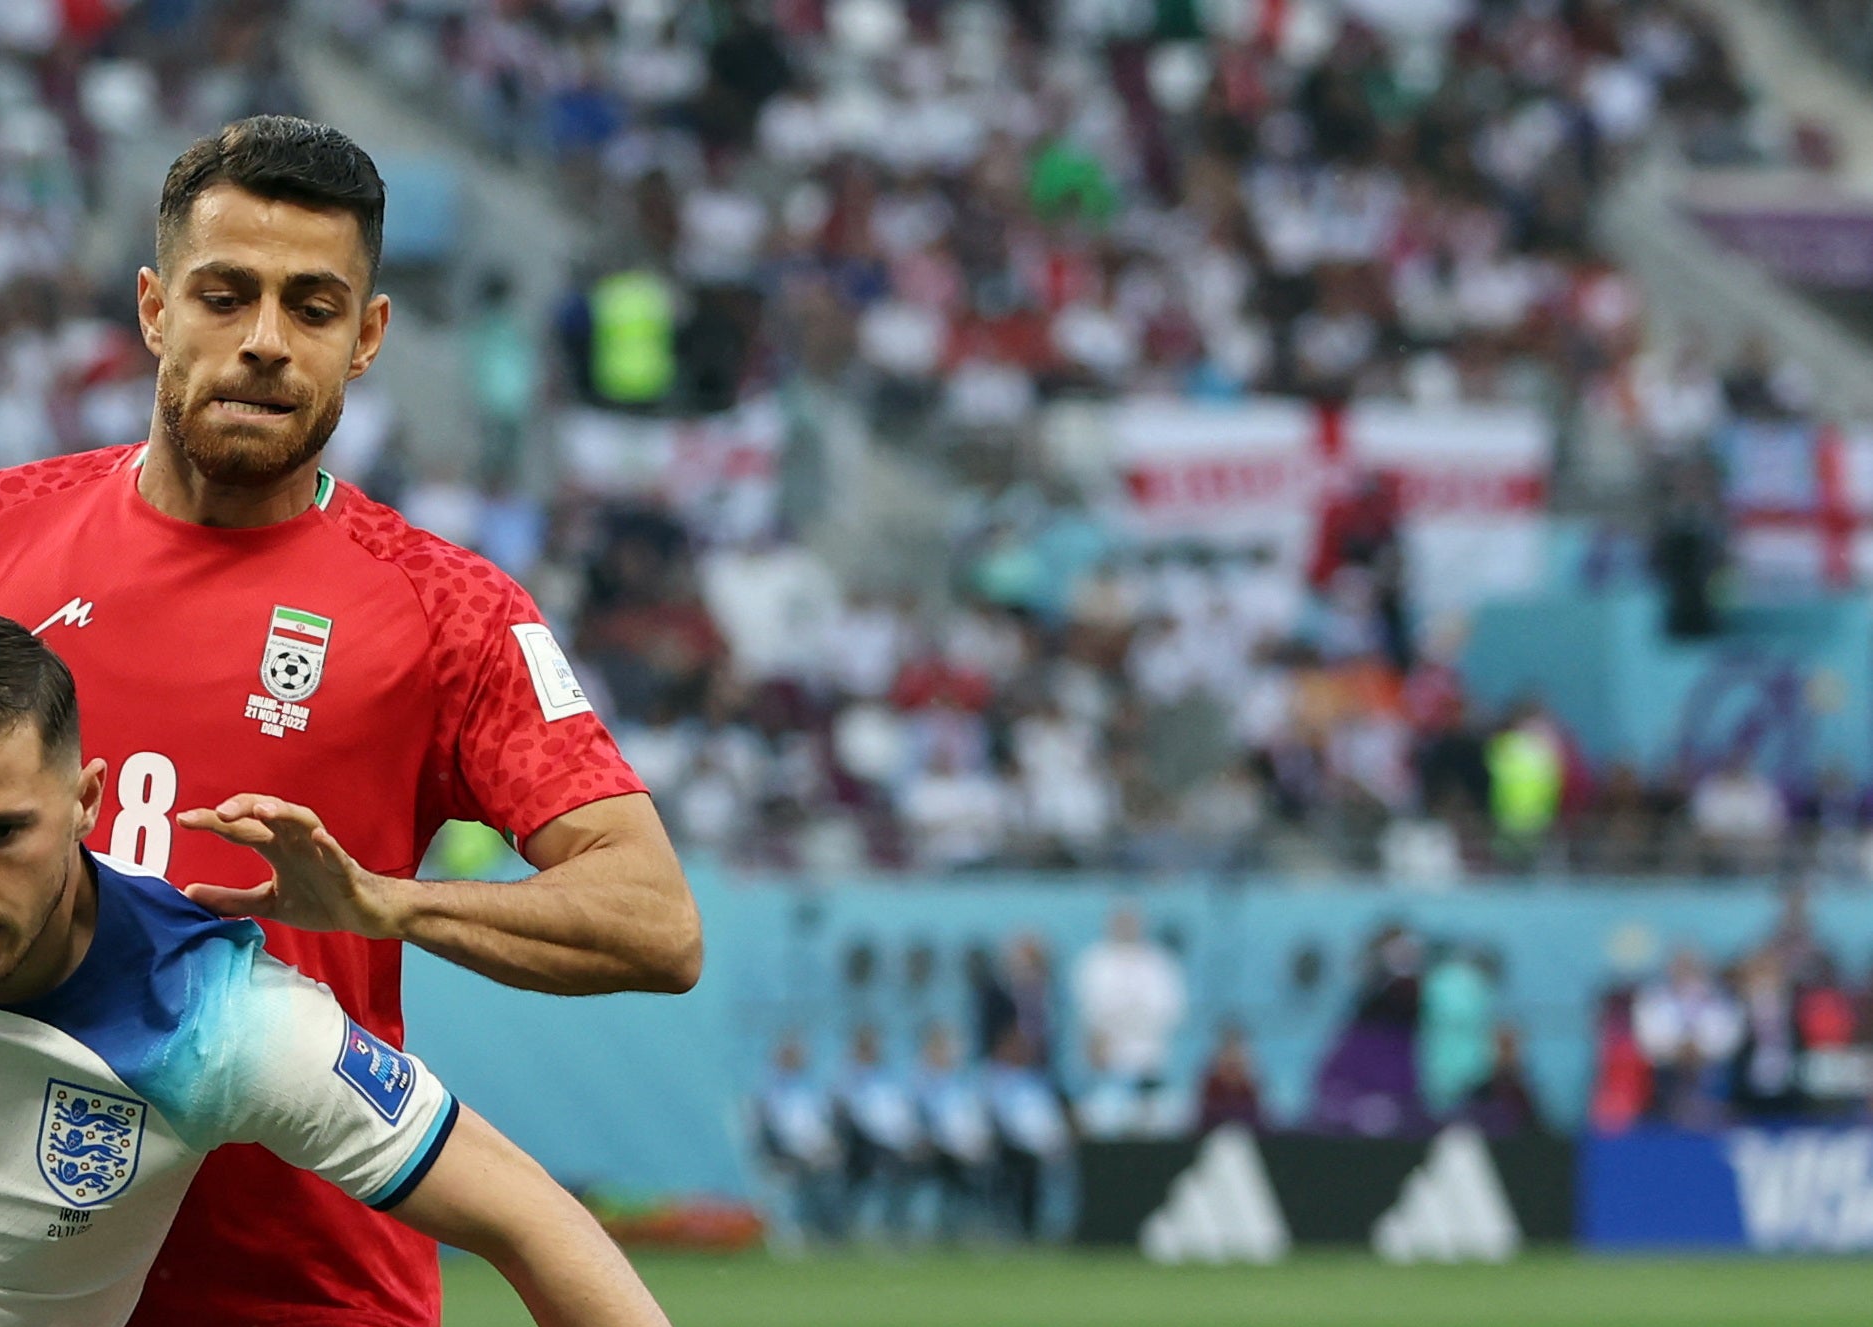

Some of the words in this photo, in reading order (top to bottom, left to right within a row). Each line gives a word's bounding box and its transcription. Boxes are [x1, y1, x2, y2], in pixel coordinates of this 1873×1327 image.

[244, 705, 258, 719] 21
[257, 708, 281, 724] NOV
[280, 714, 307, 731] 2022
[110, 751, 177, 878] 8
